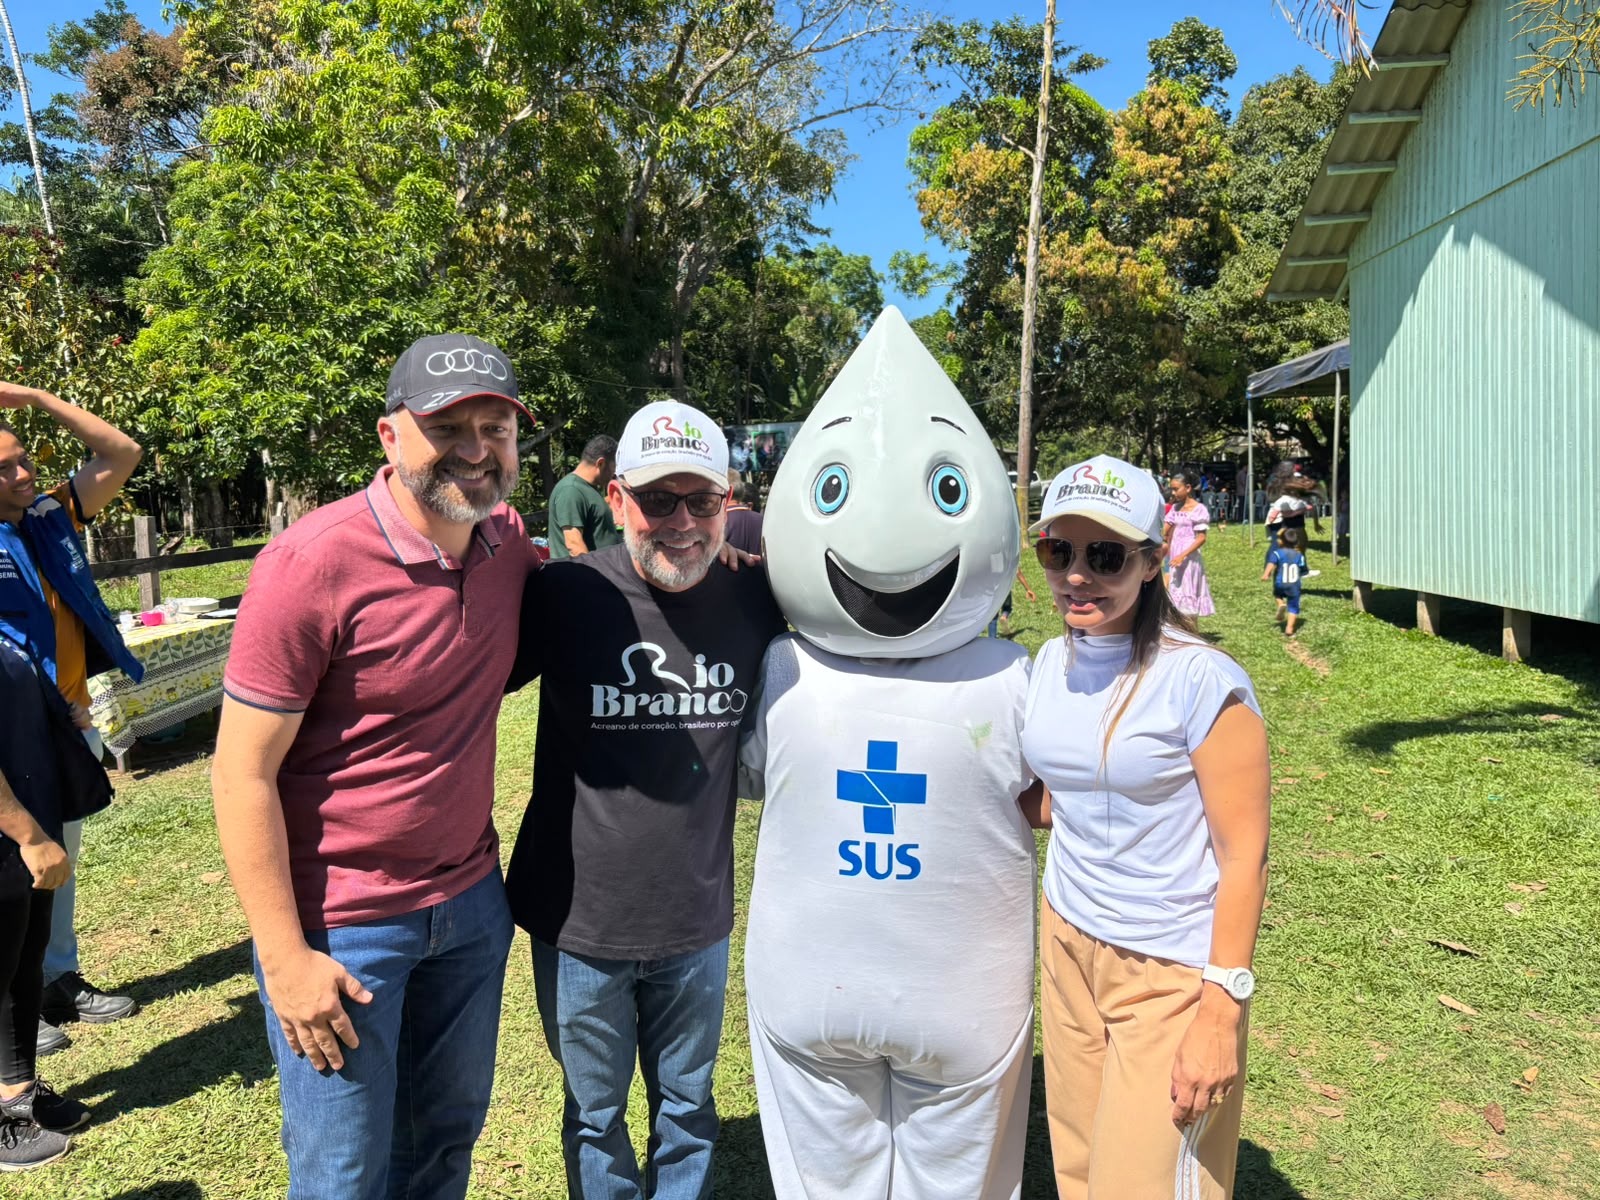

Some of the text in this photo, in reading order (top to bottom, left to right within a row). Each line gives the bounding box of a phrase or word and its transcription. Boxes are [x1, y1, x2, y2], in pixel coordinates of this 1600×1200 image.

[422, 390, 463, 410] 27
[1282, 562, 1299, 583] 10
[619, 641, 735, 694] Rio
[590, 684, 748, 717] Branco
[590, 721, 627, 731] Acreano
[628, 722, 640, 730] de
[679, 720, 716, 730] brasileiro
[717, 721, 730, 730] por
[838, 839, 922, 880] SUS
